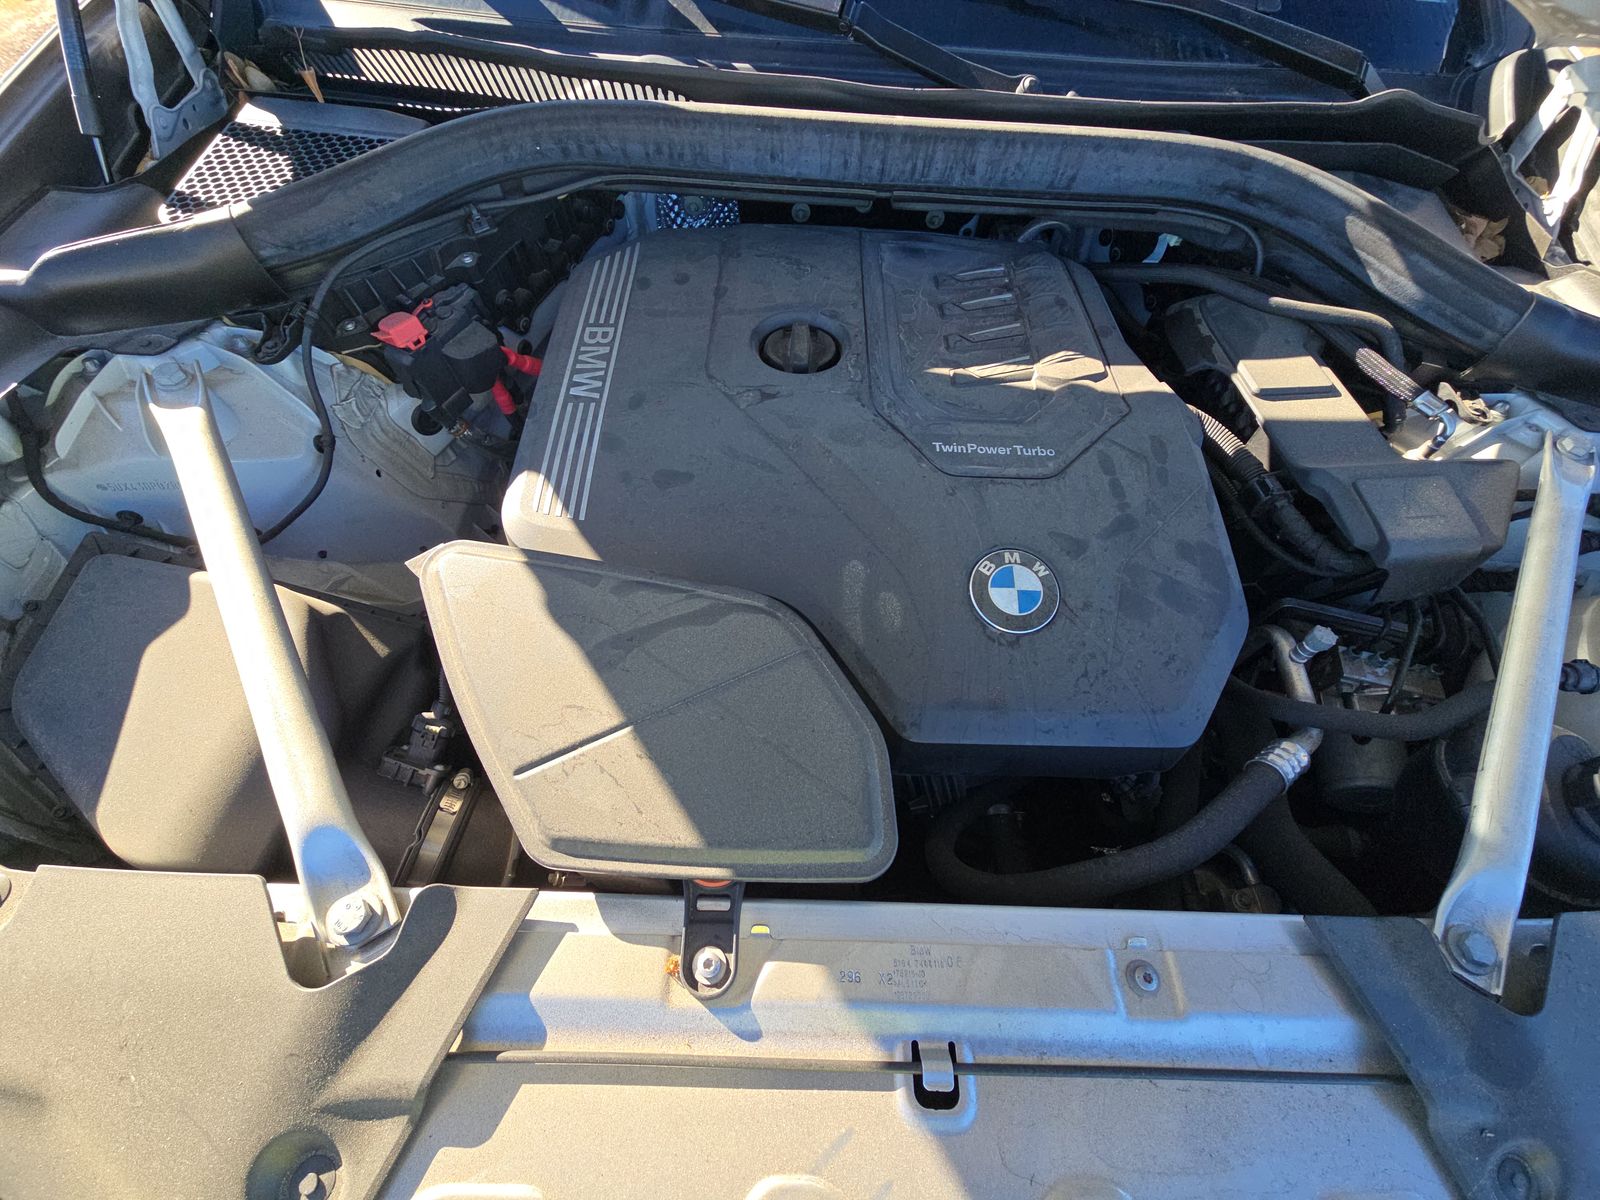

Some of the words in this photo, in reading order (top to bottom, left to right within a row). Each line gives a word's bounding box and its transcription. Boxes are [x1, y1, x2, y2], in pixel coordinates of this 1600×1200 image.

[569, 326, 616, 399] BMW
[932, 442, 1012, 455] TwinPower
[1013, 445, 1056, 456] Turbo
[978, 552, 1050, 577] BMW
[839, 971, 861, 984] 296
